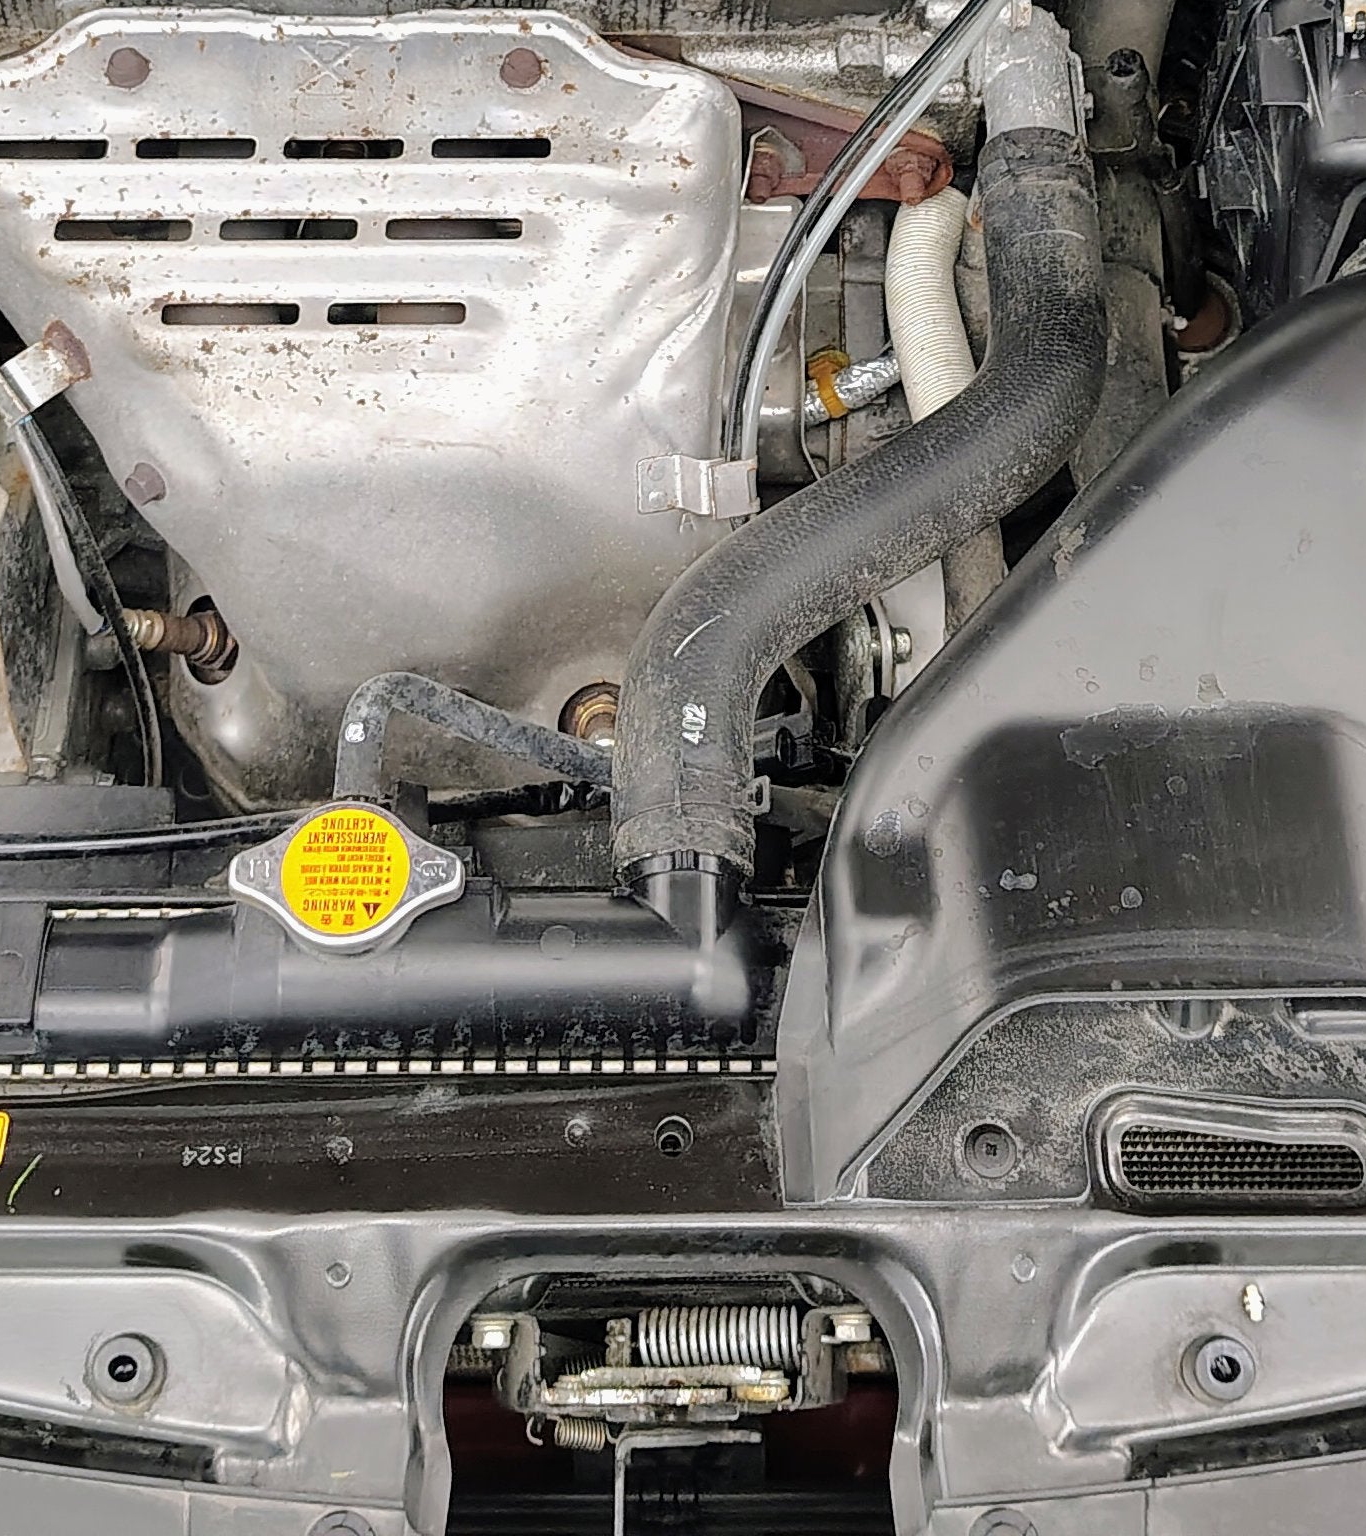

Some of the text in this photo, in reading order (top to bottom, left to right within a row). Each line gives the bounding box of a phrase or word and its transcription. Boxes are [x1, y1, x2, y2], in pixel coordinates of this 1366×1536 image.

[681, 702, 707, 745] 402
[322, 818, 375, 830] ACHTUNG
[307, 832, 388, 844] AVERTISSEMENT
[303, 899, 355, 911] WARNING
[183, 1146, 243, 1167] PS24
